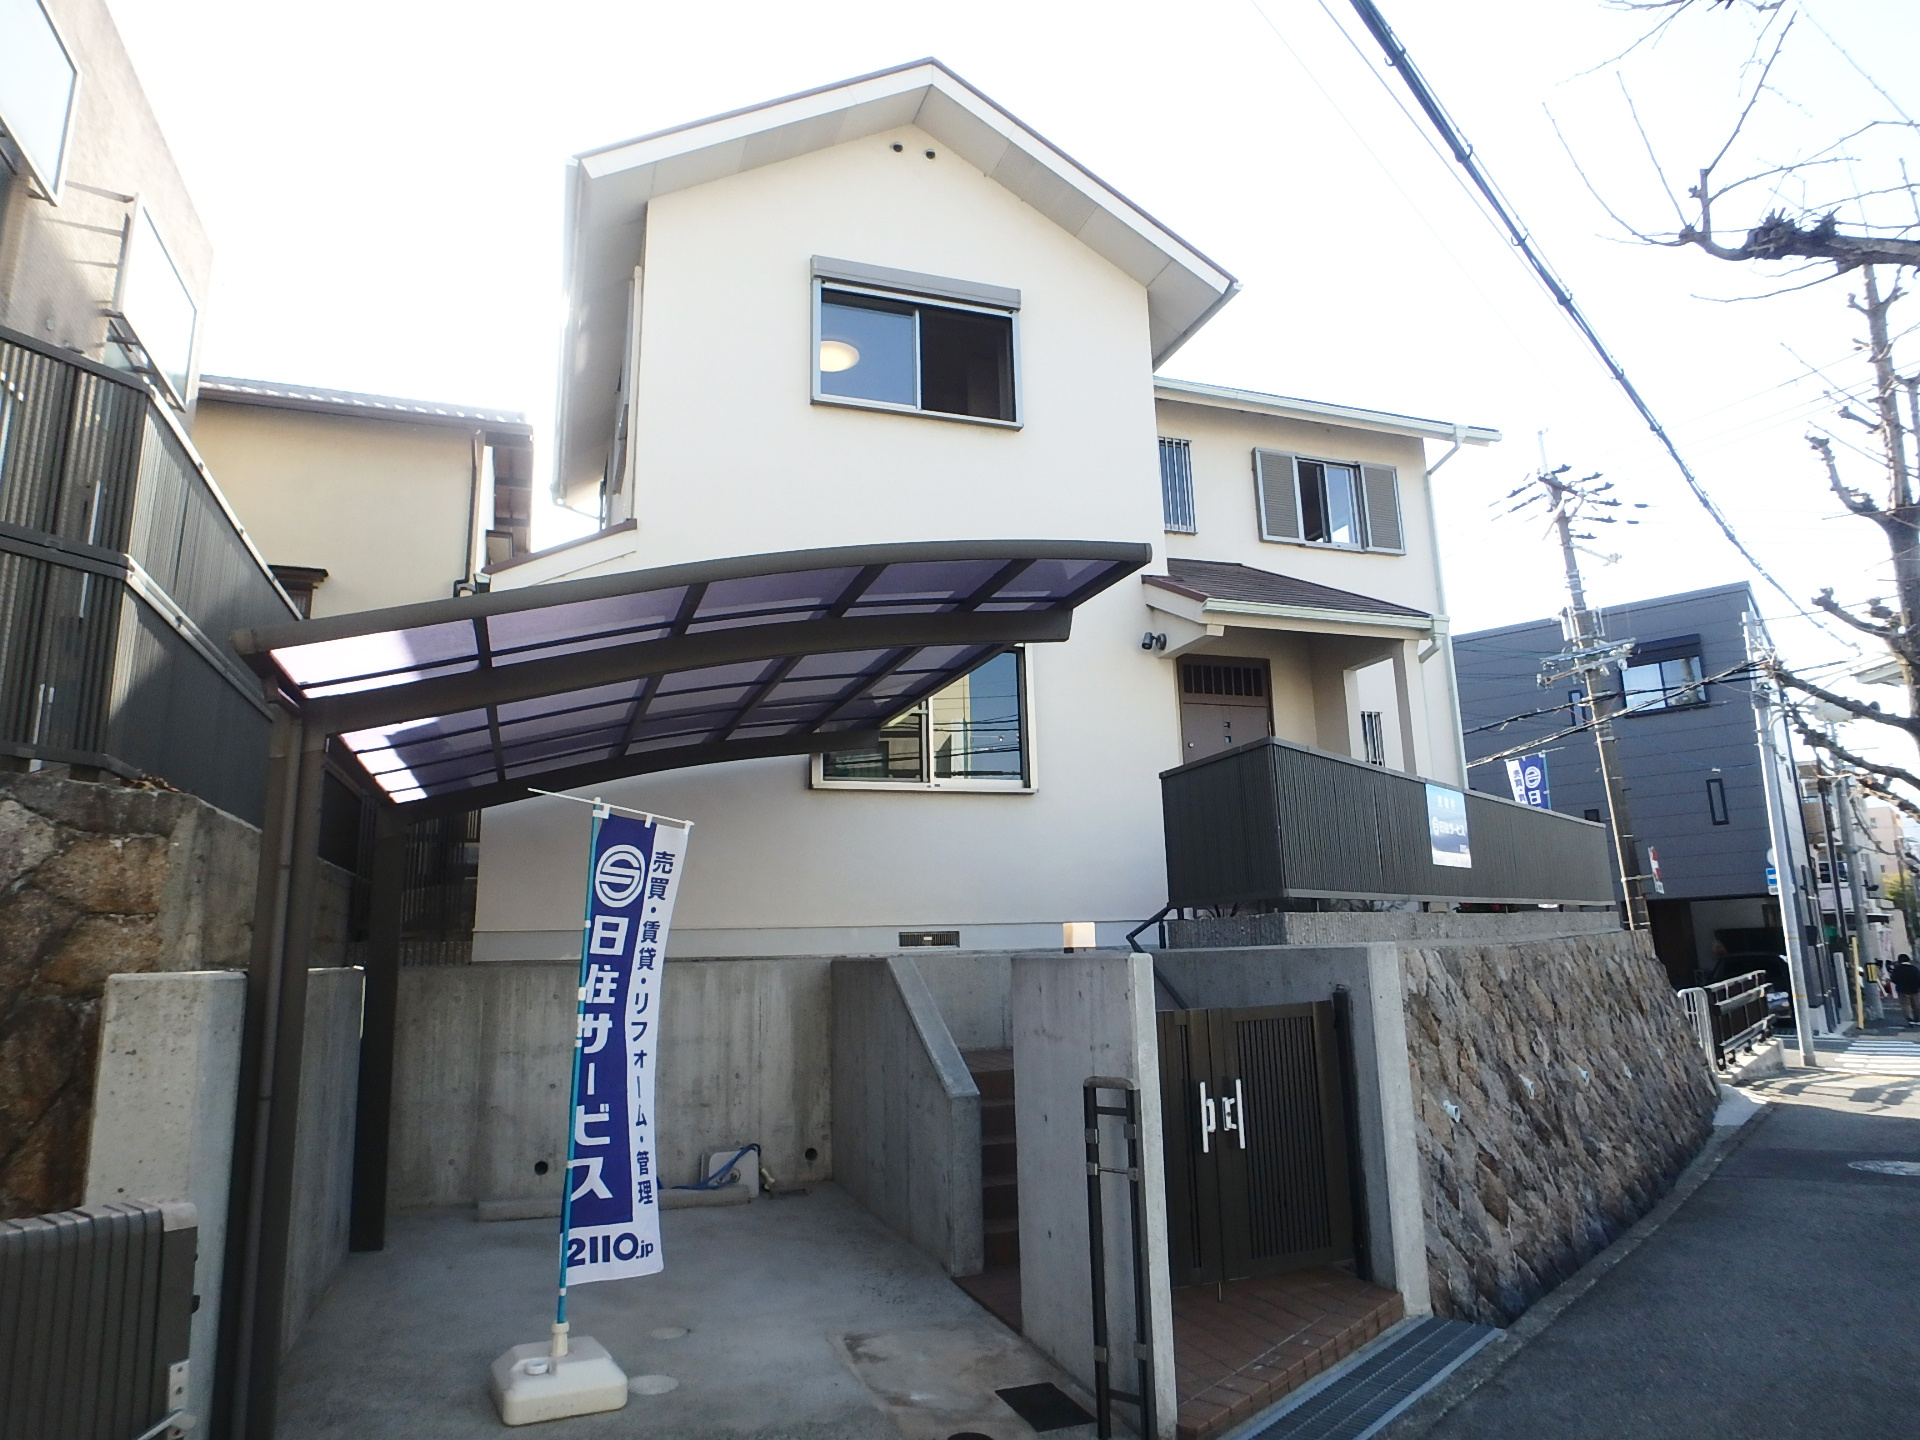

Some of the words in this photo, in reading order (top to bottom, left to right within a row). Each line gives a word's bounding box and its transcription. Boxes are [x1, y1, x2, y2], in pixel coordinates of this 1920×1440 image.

[570, 914, 629, 1202] 日住サービス
